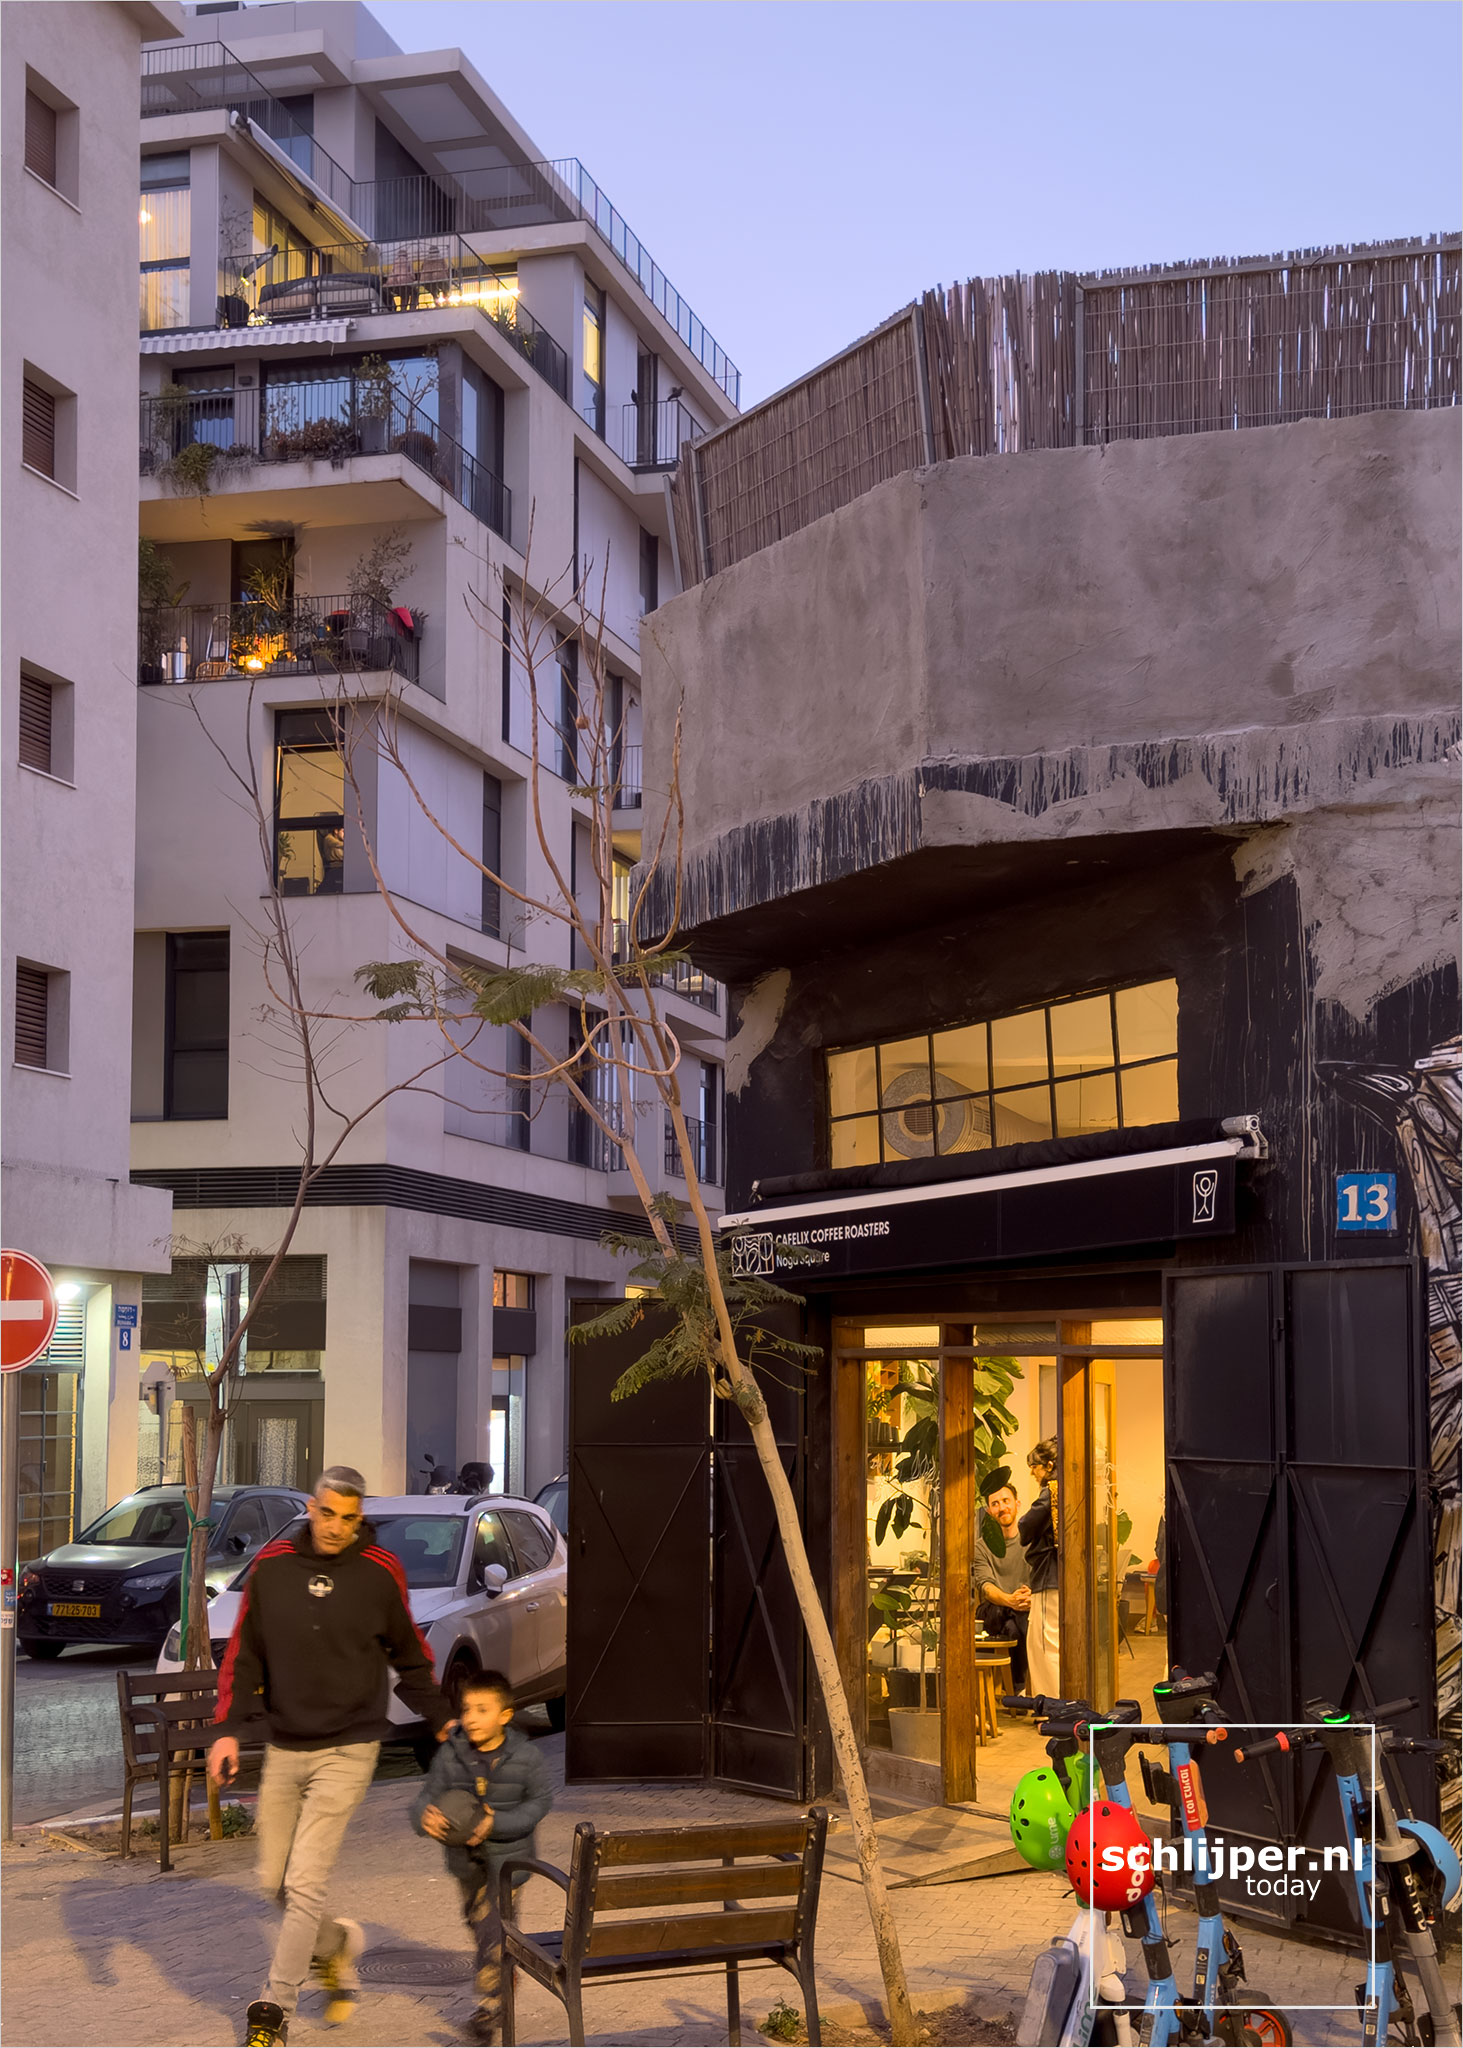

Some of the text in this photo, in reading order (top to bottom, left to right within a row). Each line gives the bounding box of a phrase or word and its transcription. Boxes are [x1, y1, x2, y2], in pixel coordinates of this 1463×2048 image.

[1342, 1184, 1389, 1221] 13
[775, 1221, 890, 1246] CAFELIX COFFEE ROASTERS
[799, 1251, 830, 1268] qure
[122, 1331, 129, 1347] 8
[1126, 1843, 1145, 1903] do
